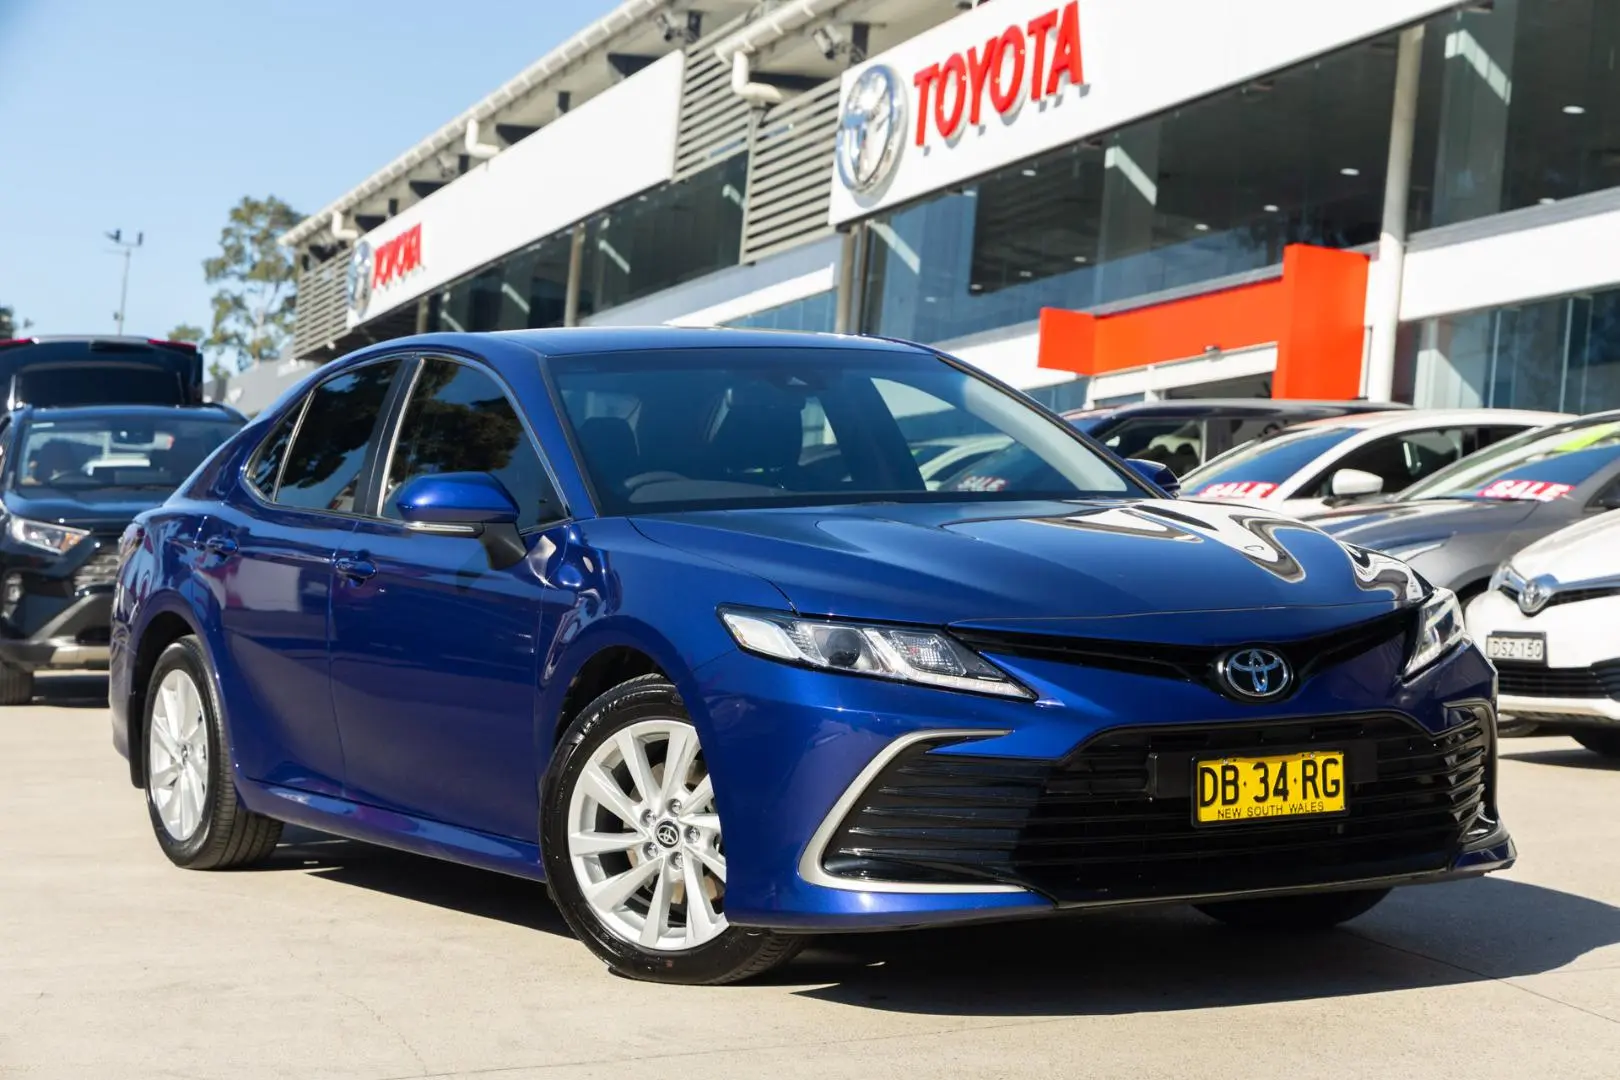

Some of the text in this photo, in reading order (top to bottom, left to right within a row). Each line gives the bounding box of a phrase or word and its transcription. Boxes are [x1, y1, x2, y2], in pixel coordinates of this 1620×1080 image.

[914, 1, 1084, 147] TOYOTA
[1482, 480, 1572, 502] SALE
[1218, 801, 1324, 819] NEW SOUTH WALES
